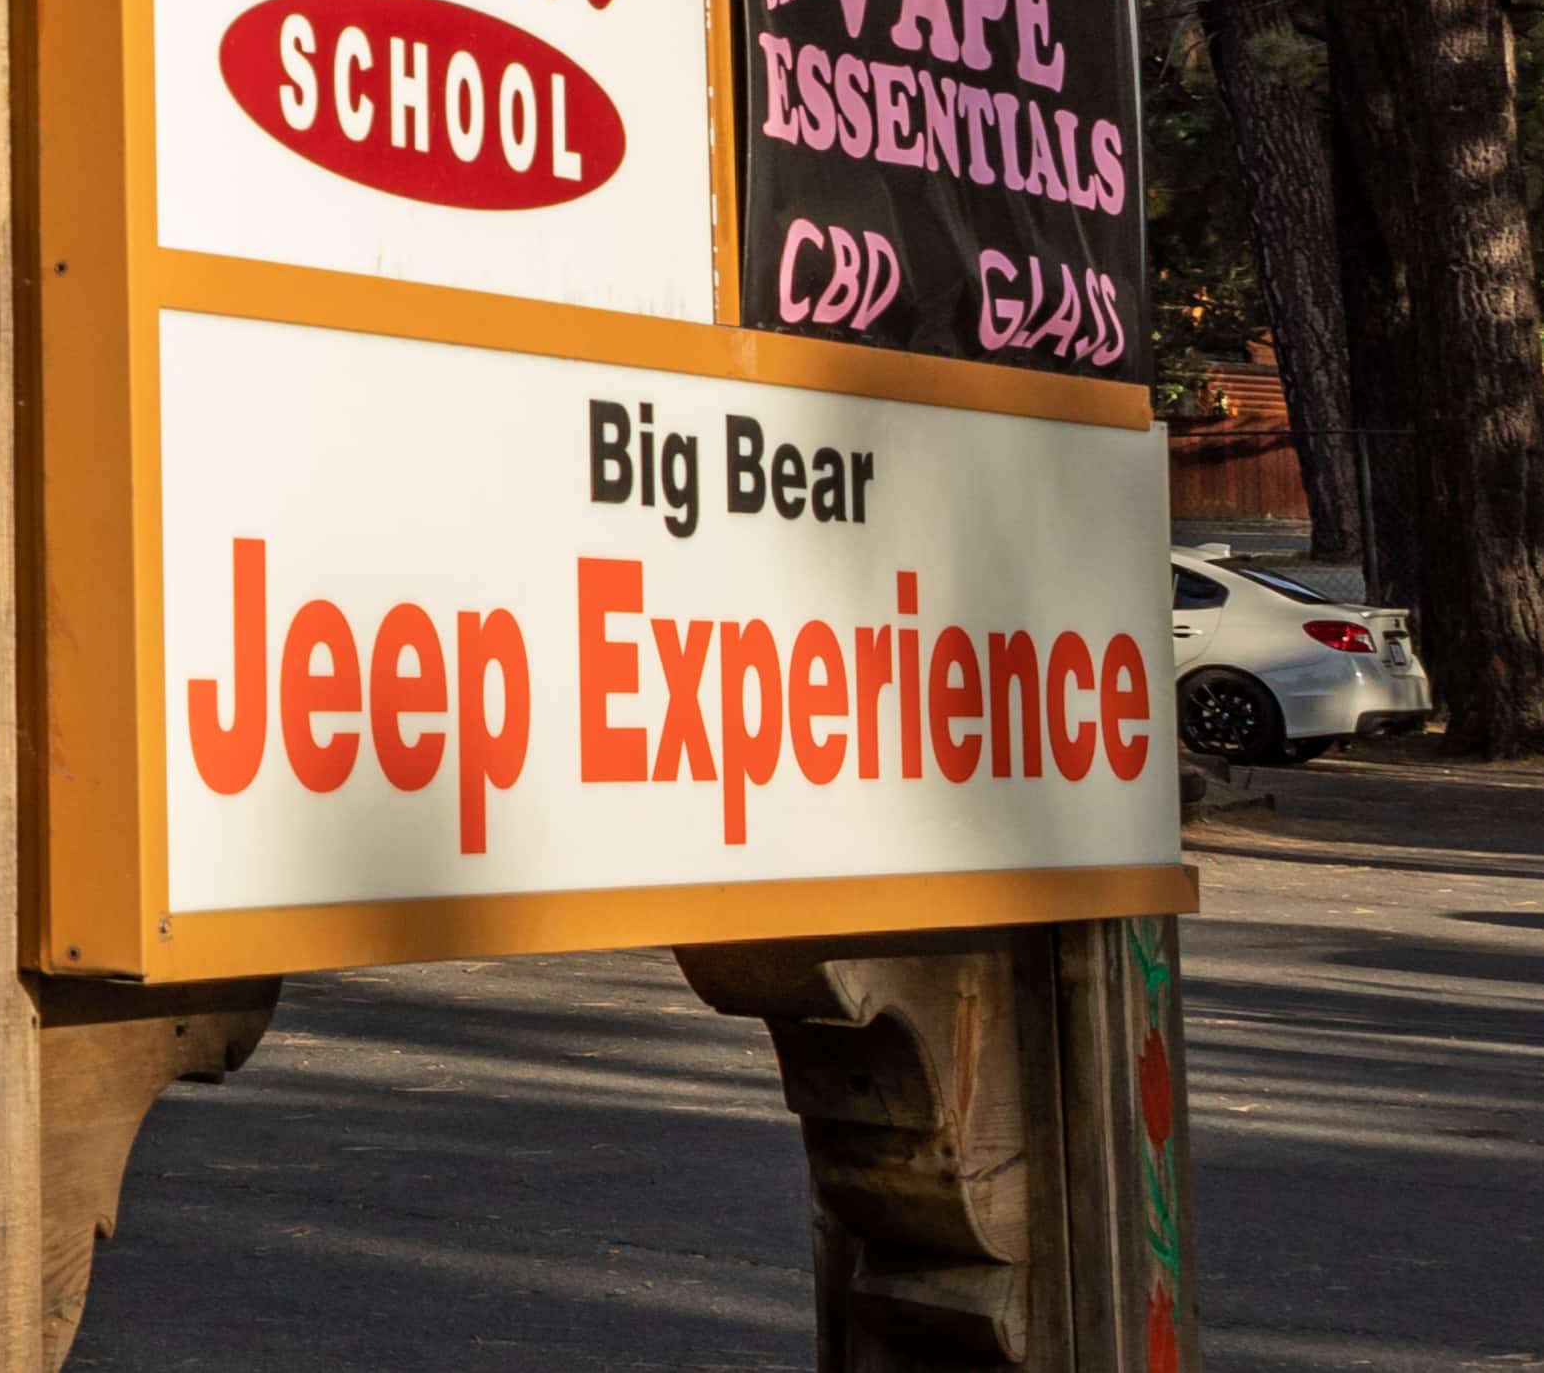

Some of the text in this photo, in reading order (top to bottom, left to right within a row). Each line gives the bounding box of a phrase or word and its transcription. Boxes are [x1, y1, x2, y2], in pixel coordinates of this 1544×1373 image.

[278, 12, 582, 183] SCHOOL
[758, 32, 1125, 216] ESSENTIALS
[779, 217, 1125, 366] CBD GLASS
[588, 398, 874, 540] Big Bear
[187, 538, 1150, 855] Jeep Experience
